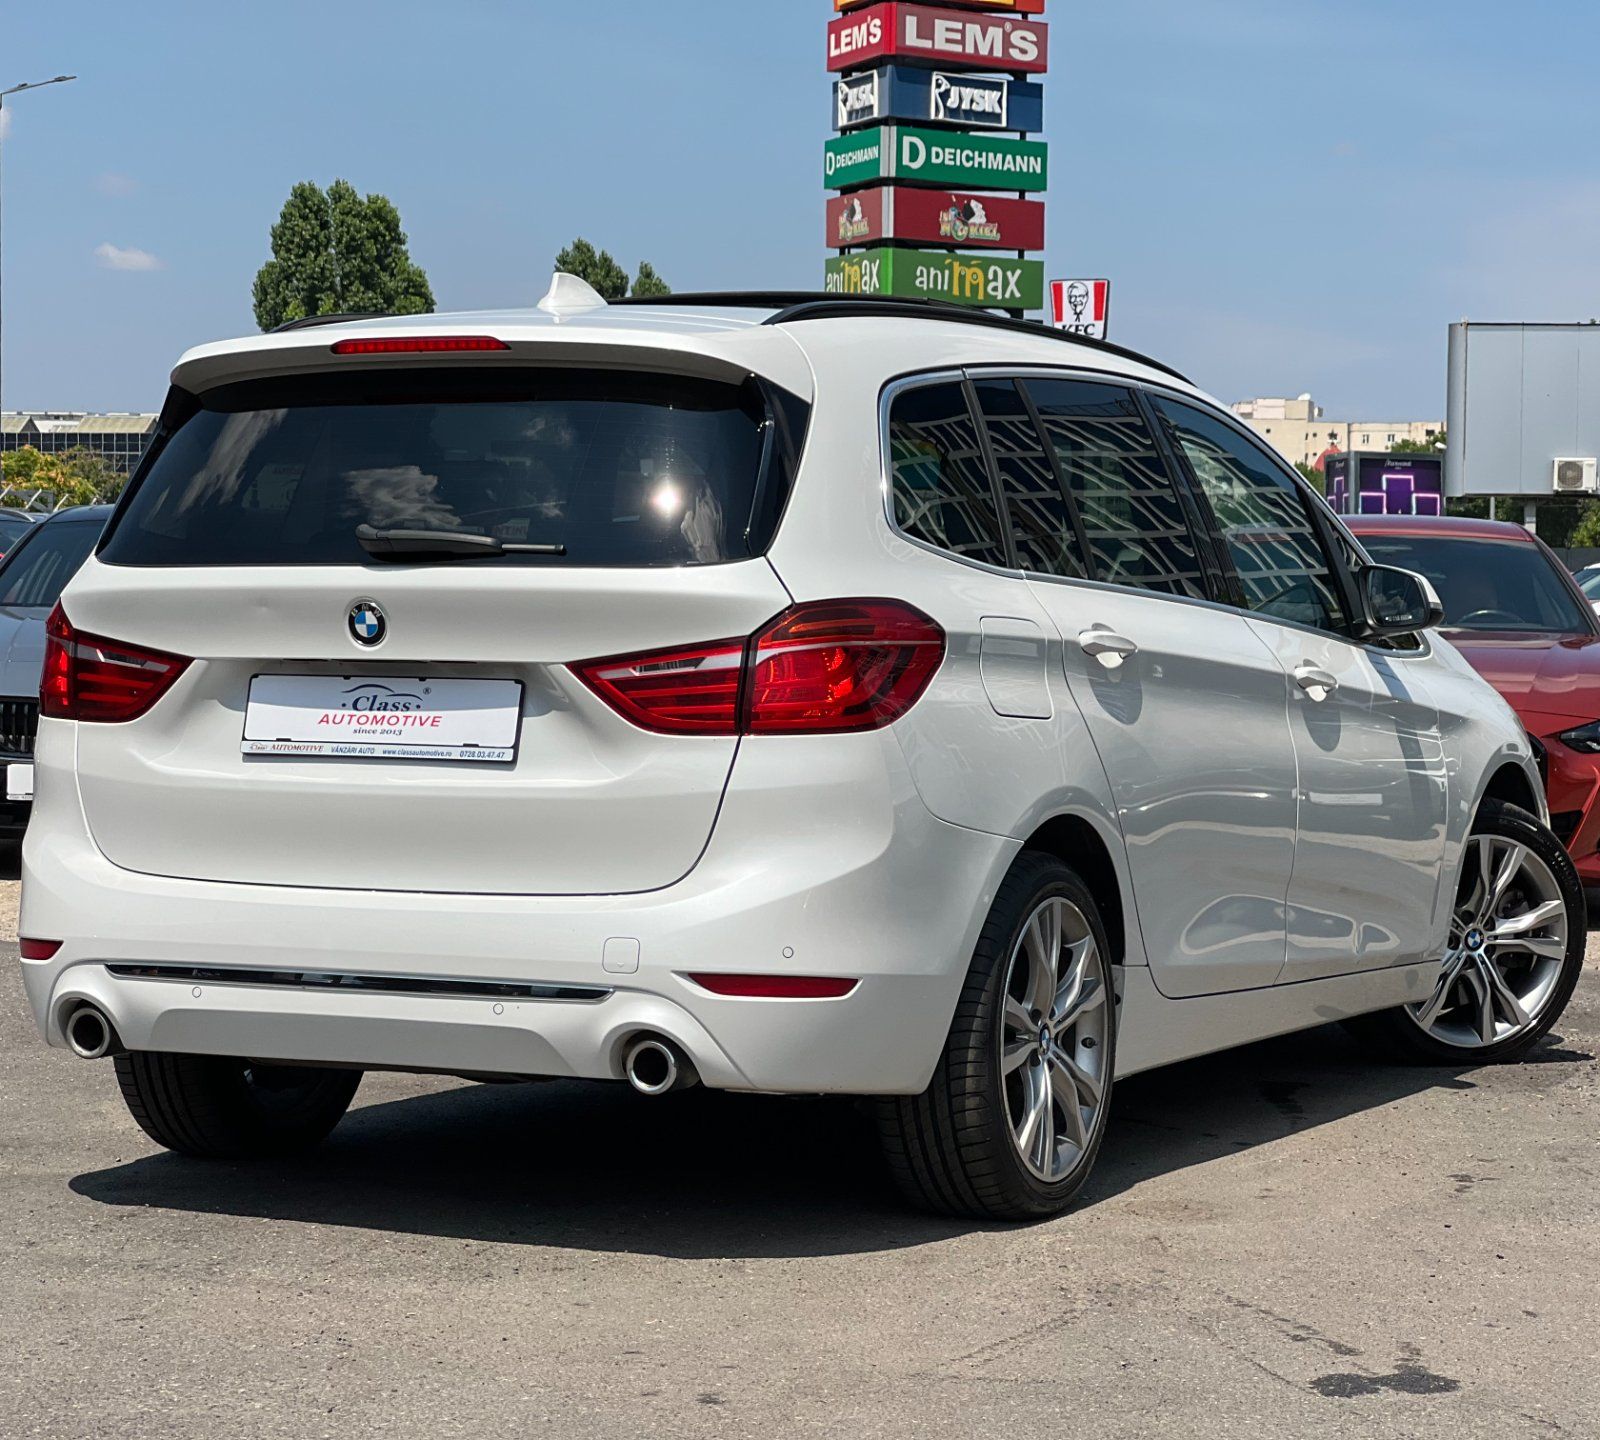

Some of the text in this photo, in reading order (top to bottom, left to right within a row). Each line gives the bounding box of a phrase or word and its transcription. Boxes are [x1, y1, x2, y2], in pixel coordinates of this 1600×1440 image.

[829, 15, 882, 57] LEM'S
[946, 86, 1002, 113] JYSK
[826, 145, 879, 176] D DEICHMANN
[902, 135, 1042, 174] D DEICHMANN
[826, 257, 880, 294] animax
[915, 258, 1021, 300] animax
[350, 603, 382, 618] BMW
[351, 694, 412, 712] Class
[318, 713, 443, 728] AUTOMOTIVE
[353, 727, 402, 736] since 2013
[271, 743, 325, 752] AUTOMOTIVE
[358, 746, 375, 755] AUTO
[382, 747, 453, 757] www.classautomotive.ro
